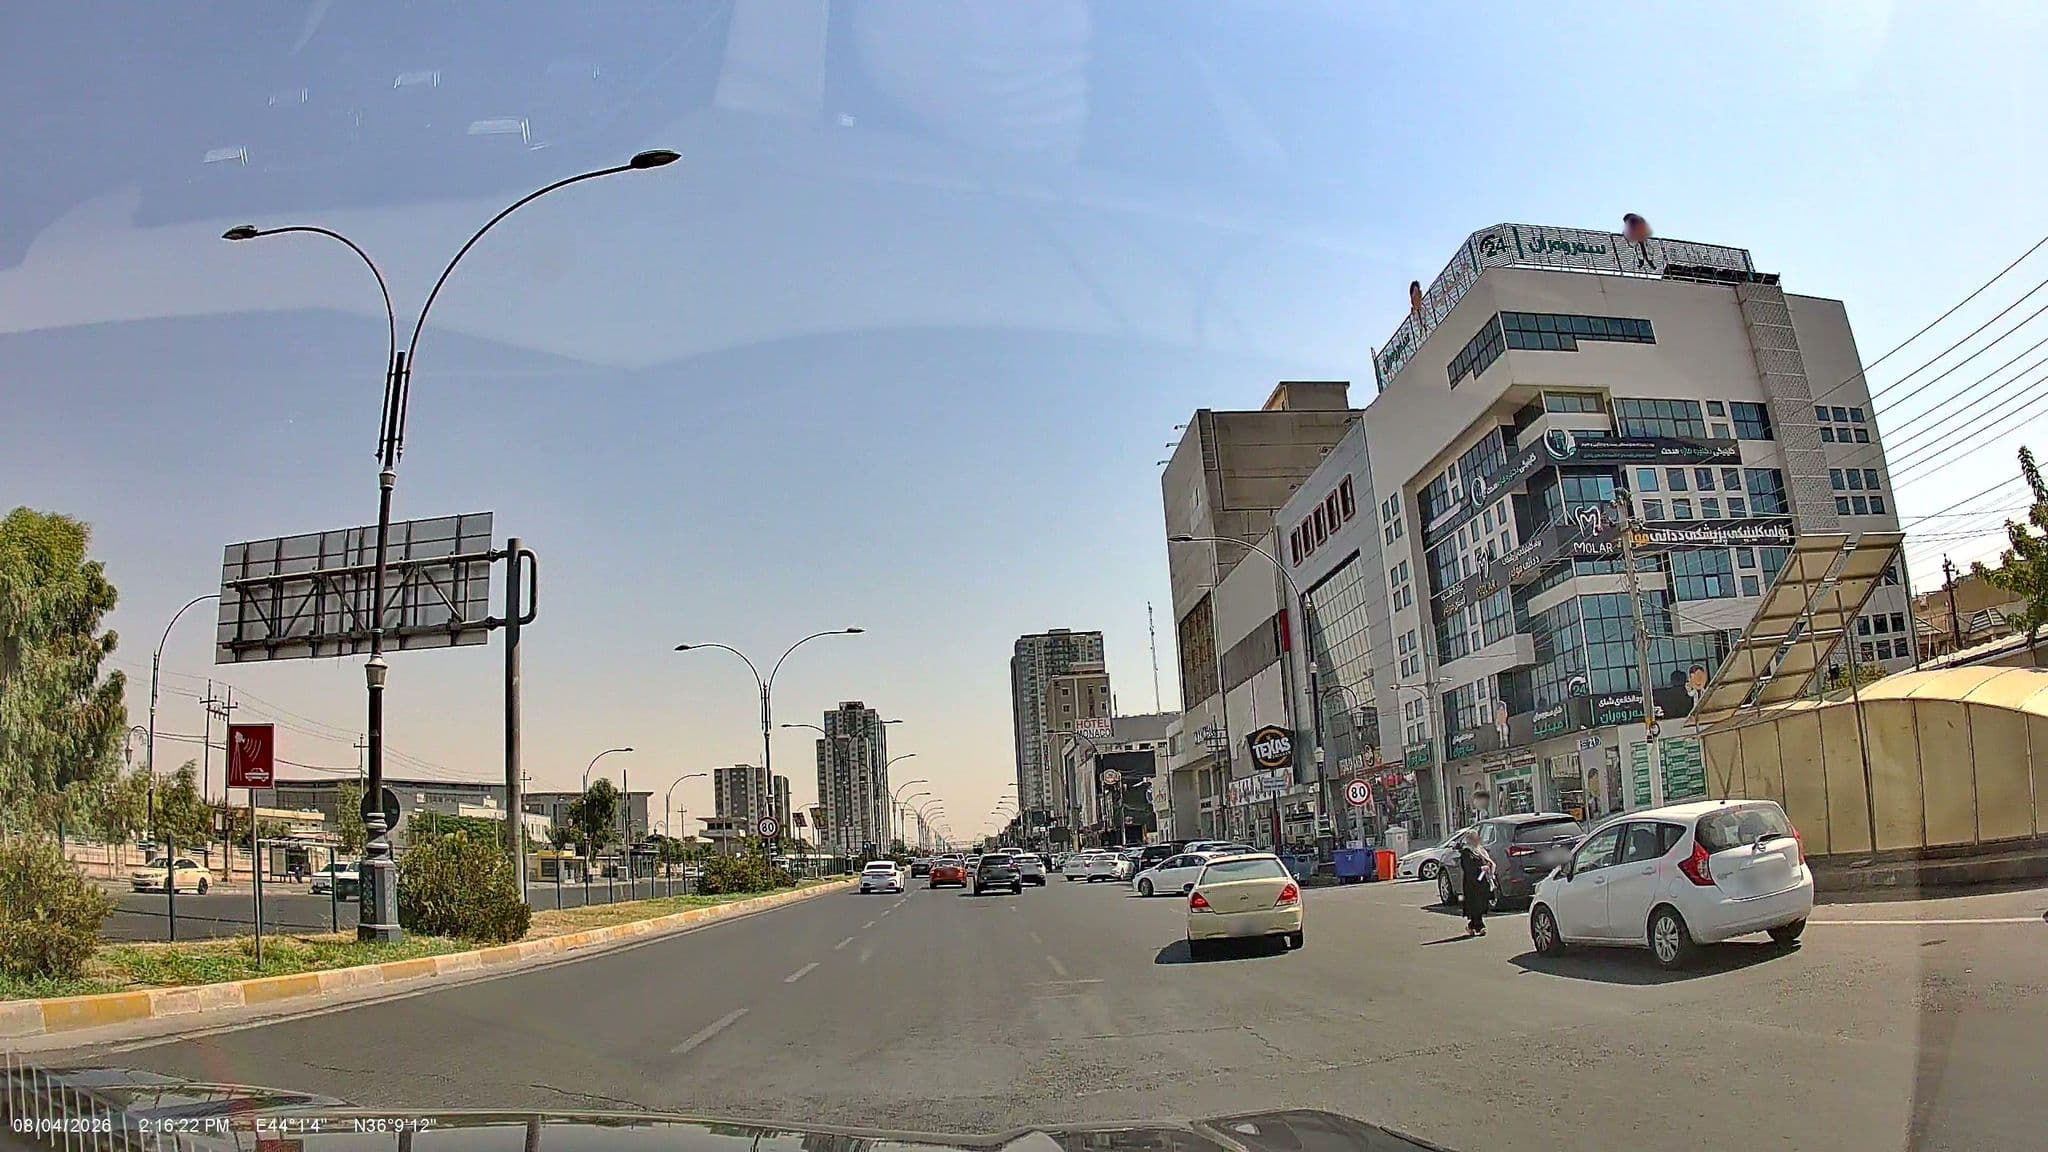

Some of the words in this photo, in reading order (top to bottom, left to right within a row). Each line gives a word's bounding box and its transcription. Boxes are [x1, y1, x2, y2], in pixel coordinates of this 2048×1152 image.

[1573, 542, 1613, 553] MOLAR
[1573, 685, 1588, 697] 24
[1076, 719, 1109, 728] HOTEL
[1252, 737, 1291, 759] TEXAS
[1351, 786, 1366, 798] 80
